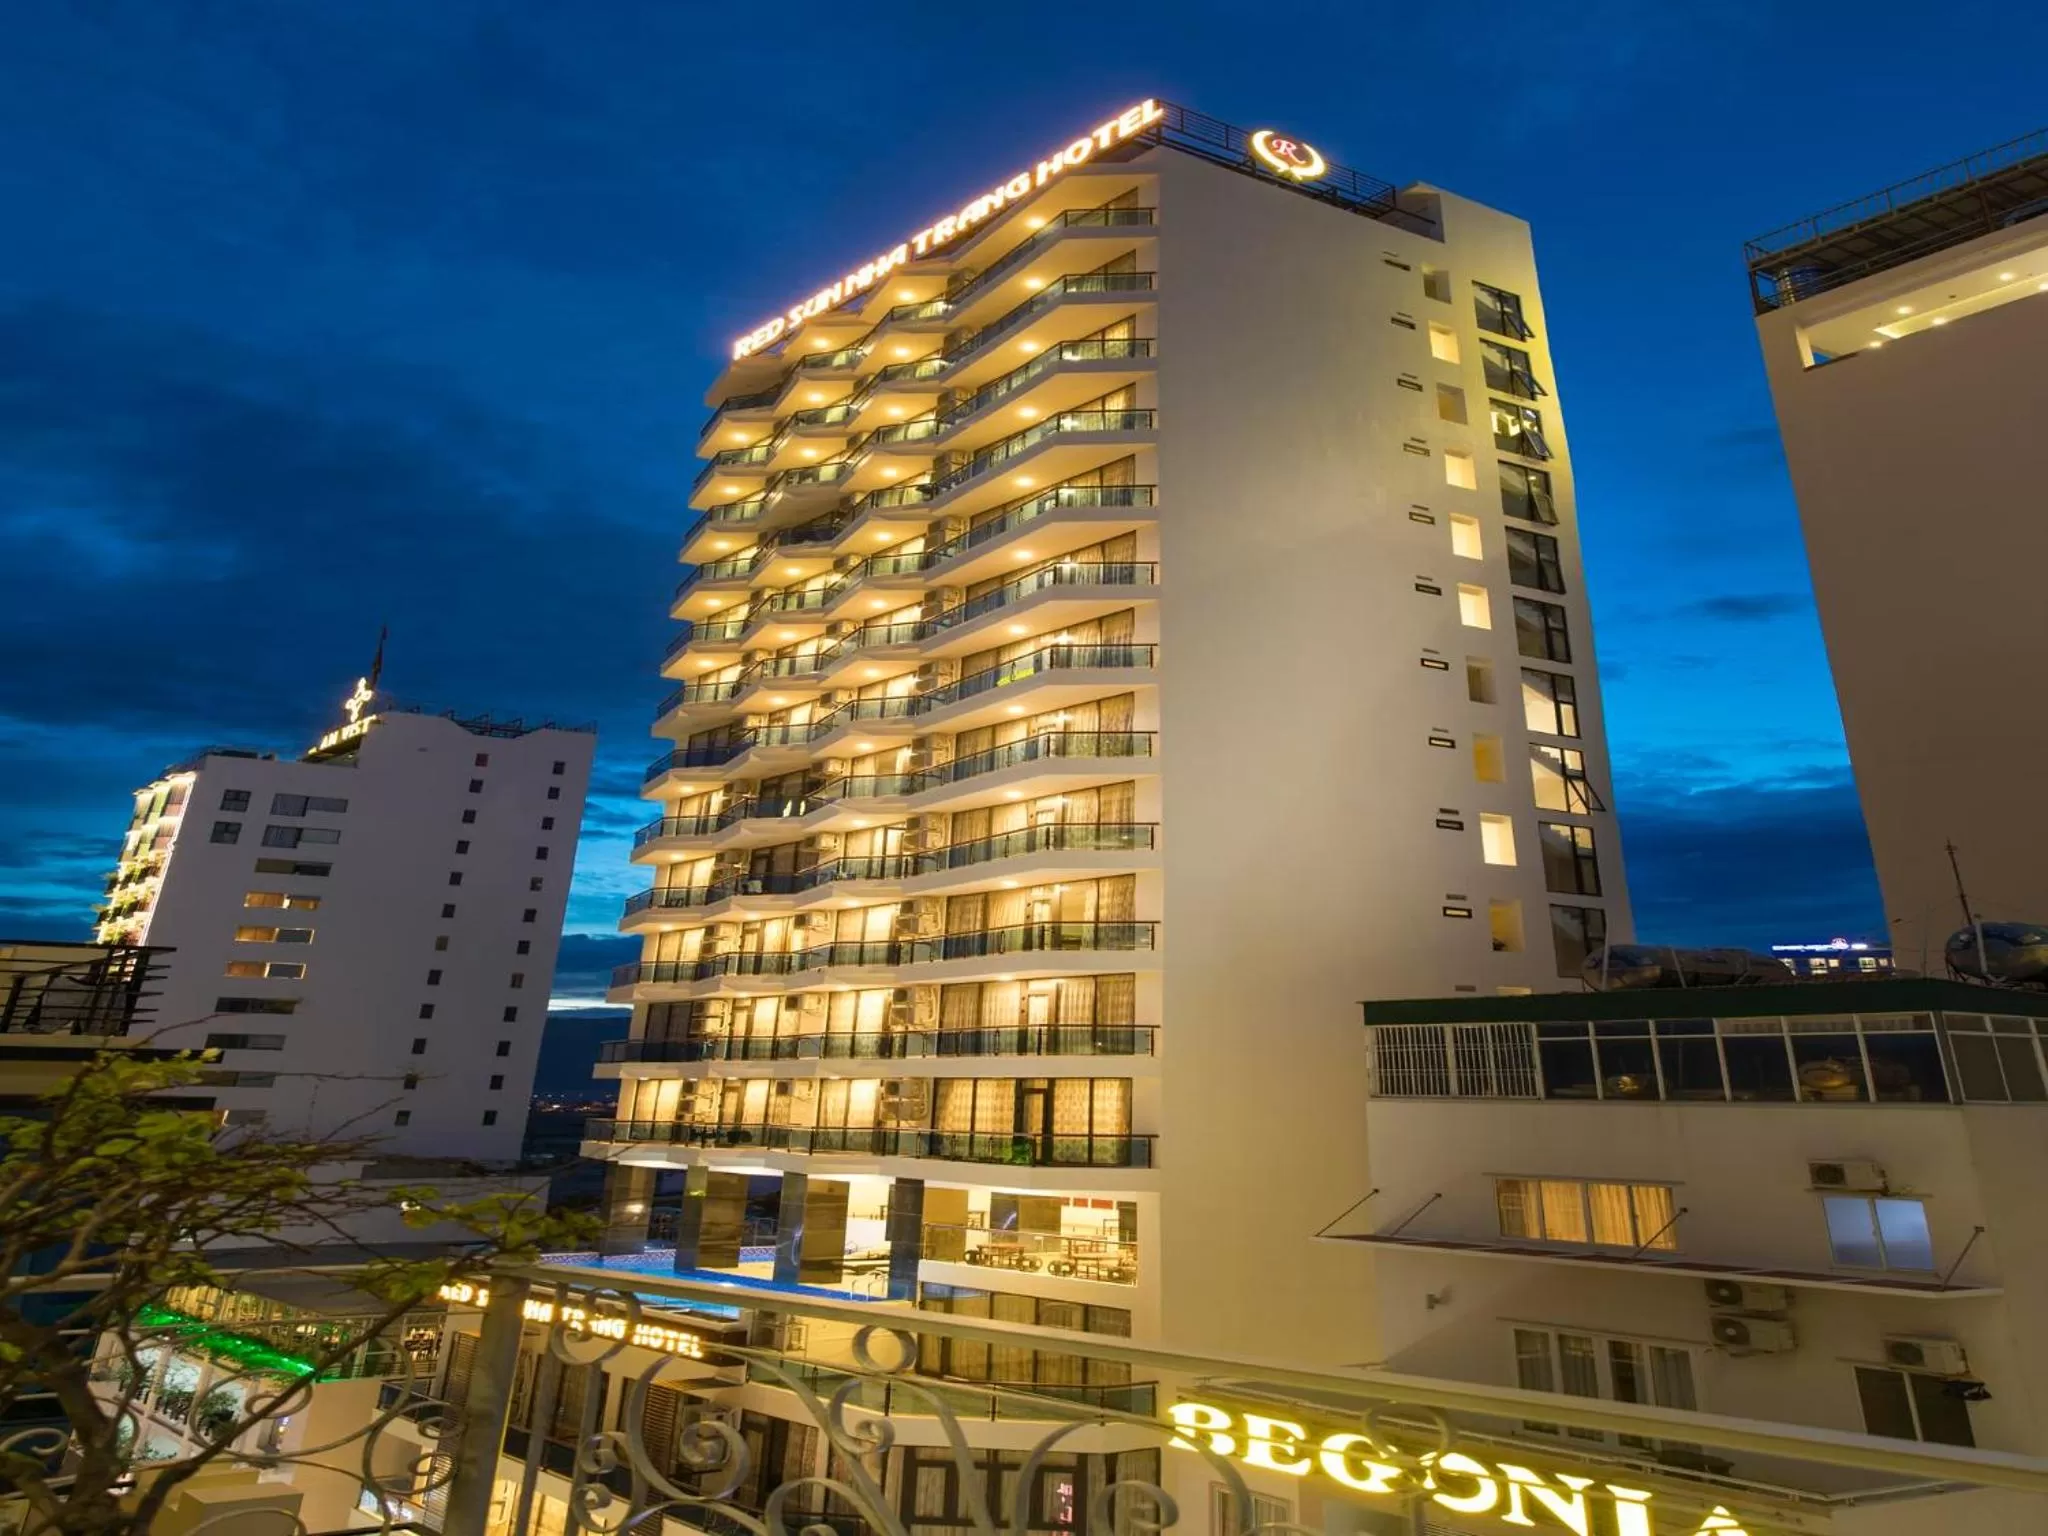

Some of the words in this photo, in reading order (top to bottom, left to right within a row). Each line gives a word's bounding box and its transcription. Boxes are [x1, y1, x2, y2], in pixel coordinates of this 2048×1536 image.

[732, 316, 786, 361] RED
[787, 281, 842, 330] SUN
[844, 242, 908, 297] NHA
[911, 171, 1031, 256] TRANG
[1035, 98, 1164, 187] HOTEL
[631, 1323, 703, 1359] HOTEL
